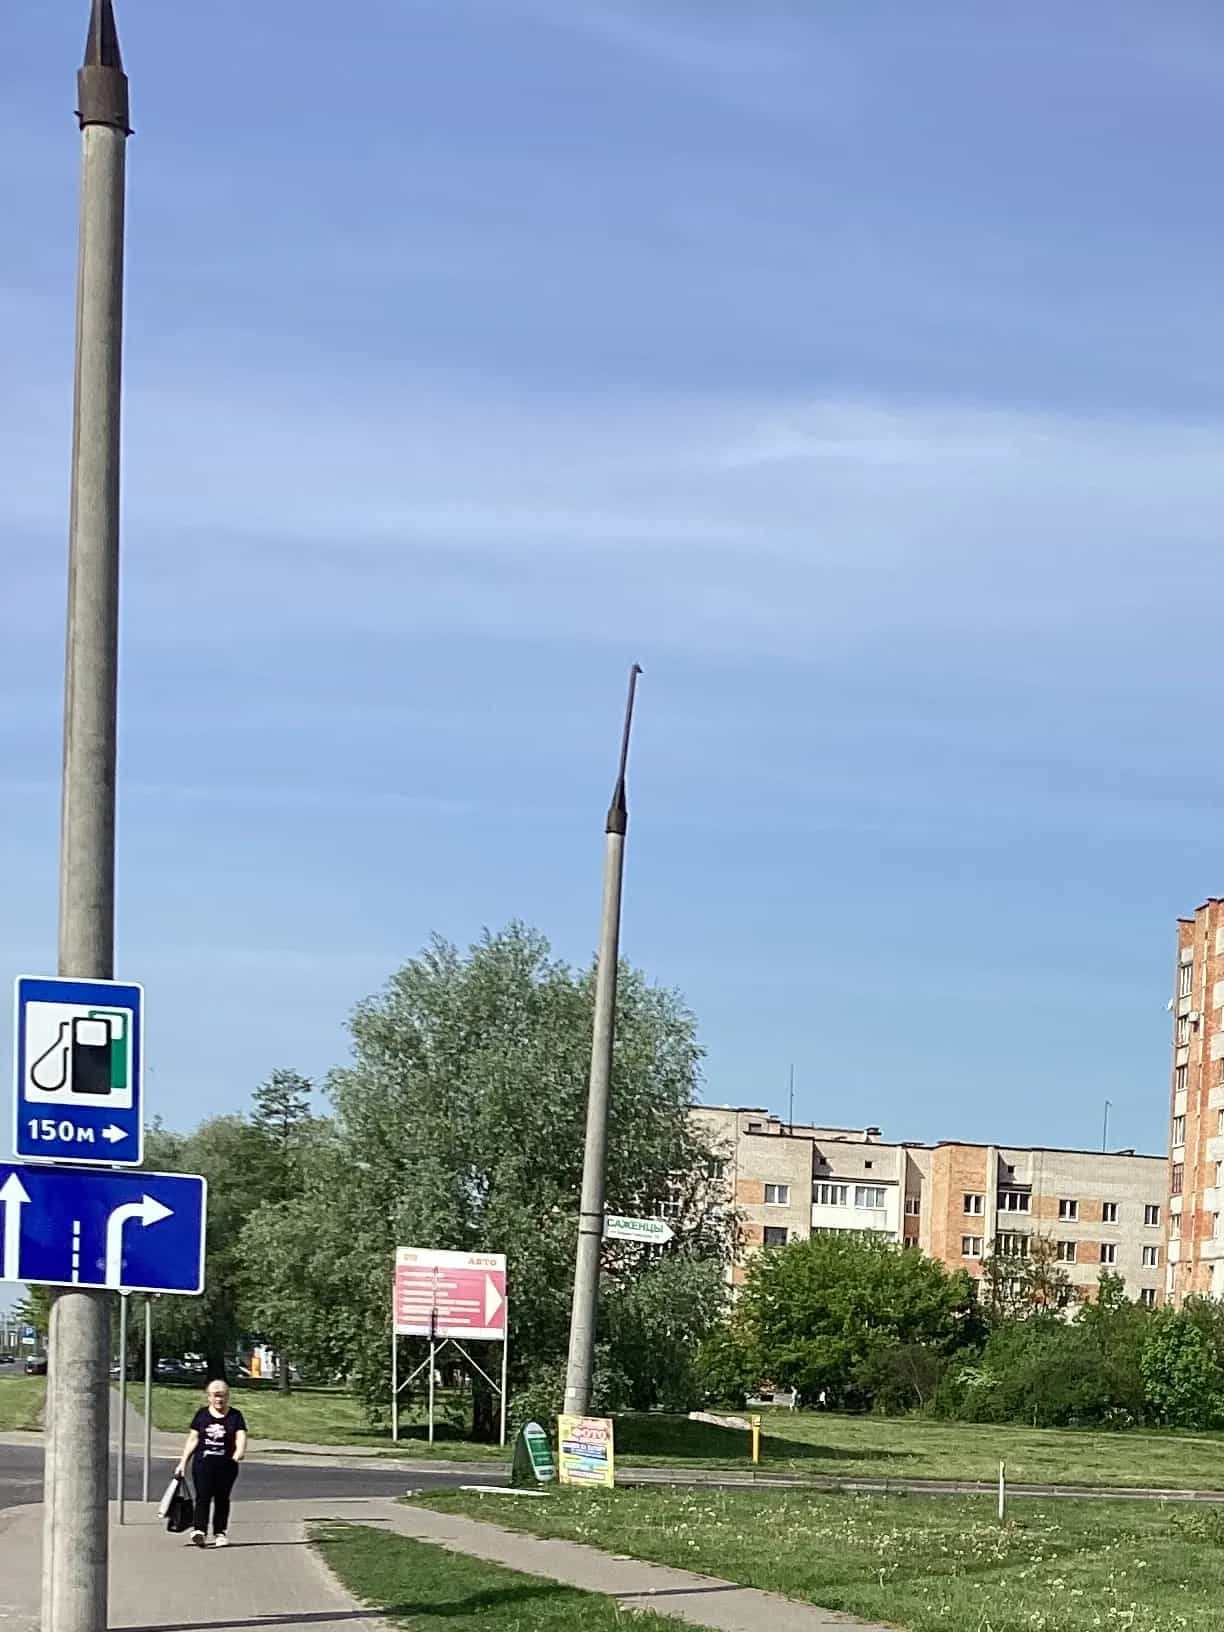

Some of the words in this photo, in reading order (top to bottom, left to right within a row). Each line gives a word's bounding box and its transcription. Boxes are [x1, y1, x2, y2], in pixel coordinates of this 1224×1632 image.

[607, 1218, 664, 1233] САЖЕНЦЫ
[468, 1257, 497, 1266] АВТО
[572, 1427, 608, 1441] ФОТО
